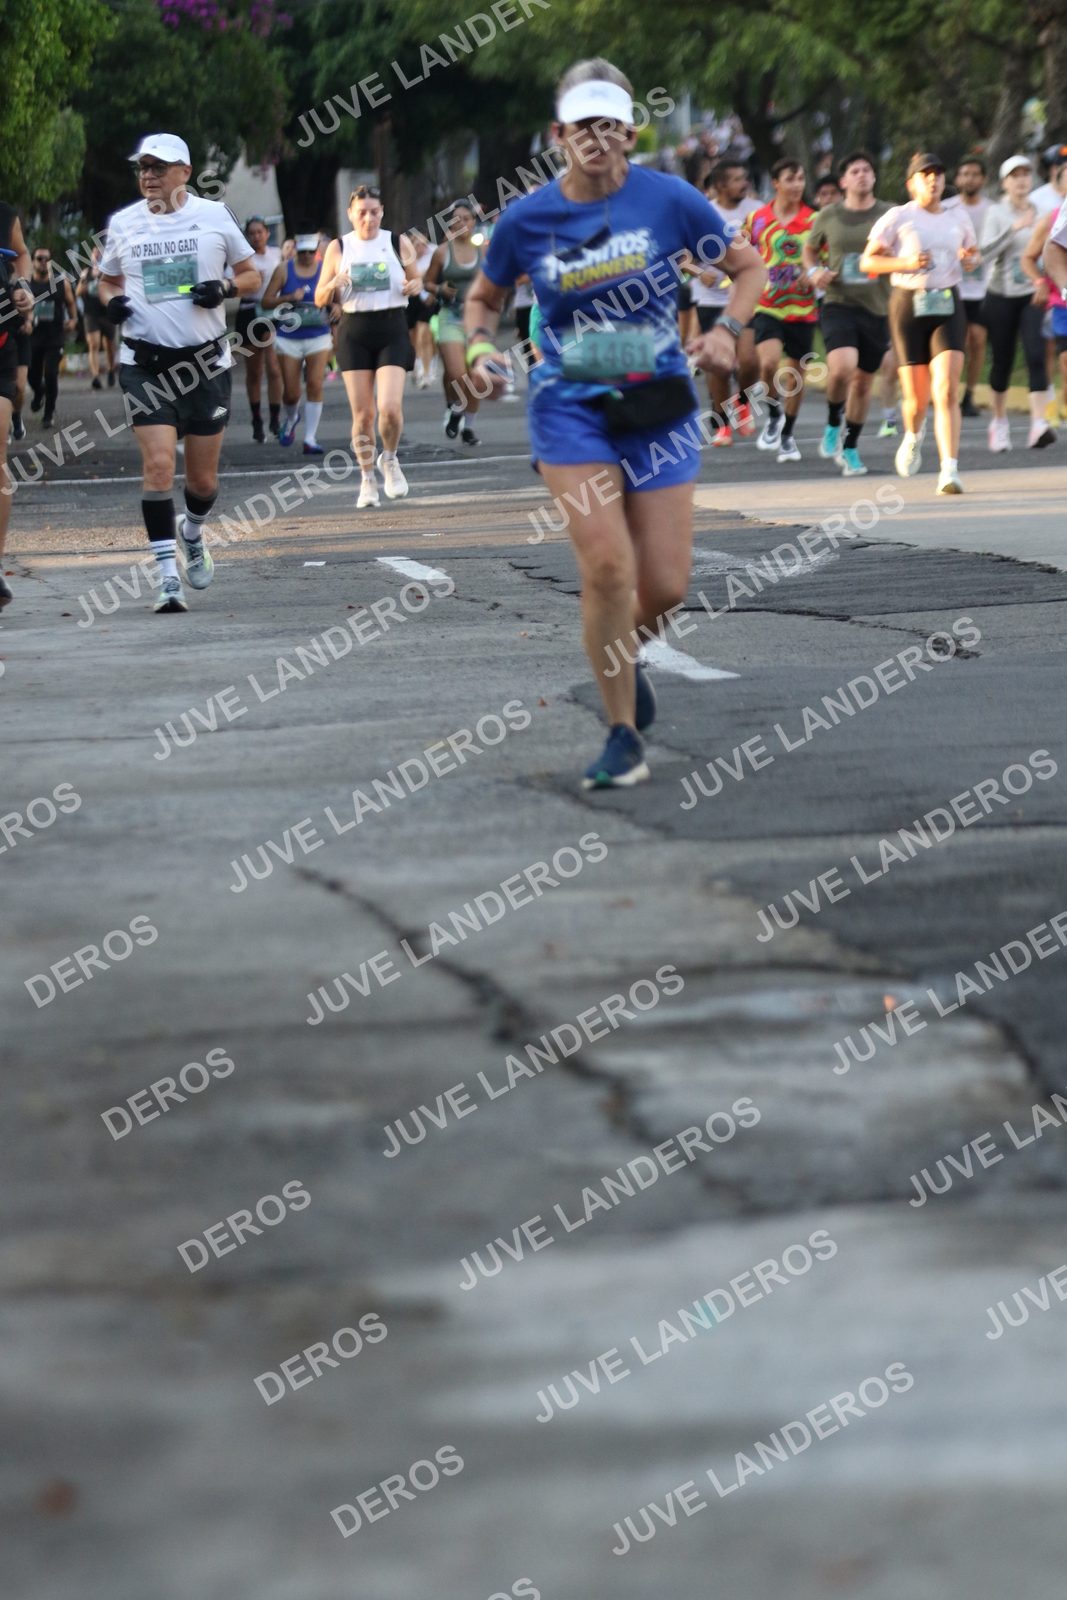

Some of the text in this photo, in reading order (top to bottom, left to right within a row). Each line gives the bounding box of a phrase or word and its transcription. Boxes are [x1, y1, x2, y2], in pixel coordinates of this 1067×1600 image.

[131, 238, 198, 258] NO PAIN NO GAIN
[560, 253, 647, 291] RUNNERS
[588, 341, 650, 369] 1461
